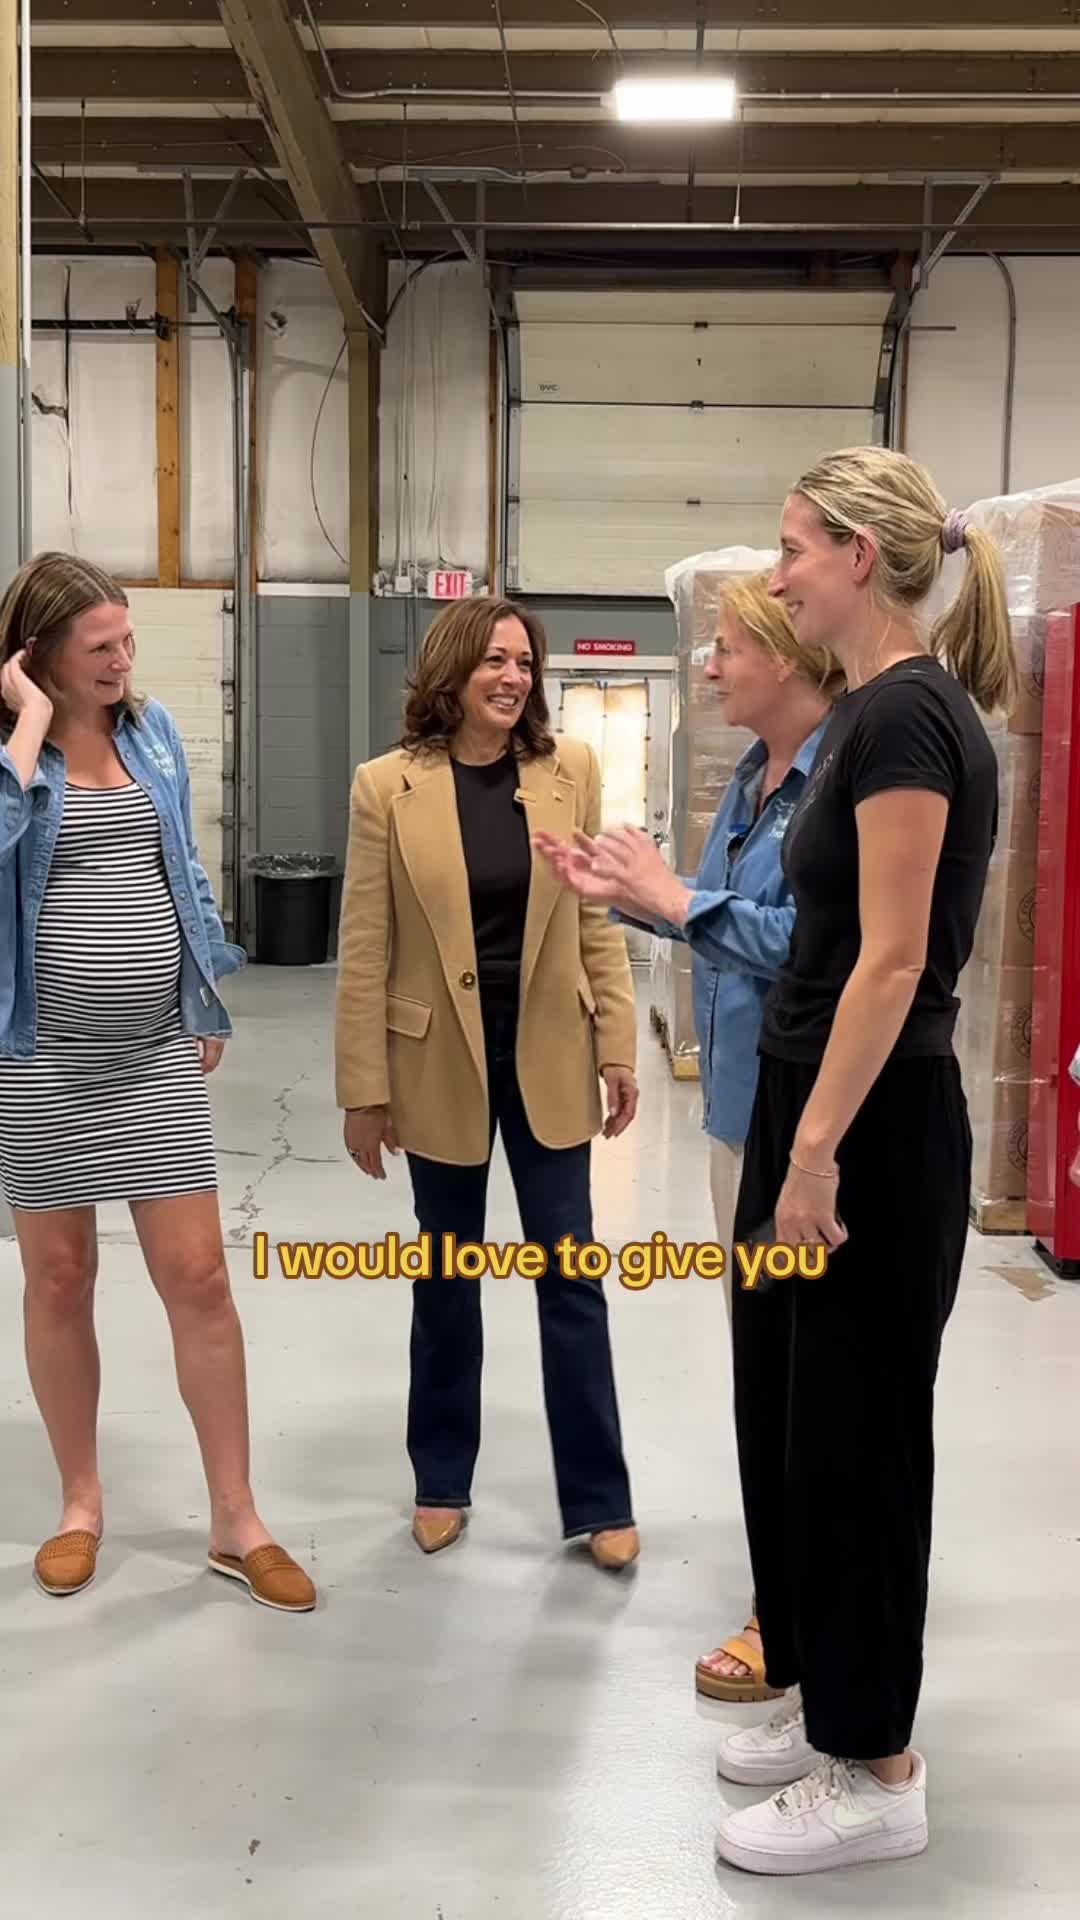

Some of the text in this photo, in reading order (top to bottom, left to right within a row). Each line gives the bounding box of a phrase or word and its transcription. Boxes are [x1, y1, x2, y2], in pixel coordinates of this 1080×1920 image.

[435, 572, 466, 598] EXIT
[576, 643, 633, 651] NO SMOKING
